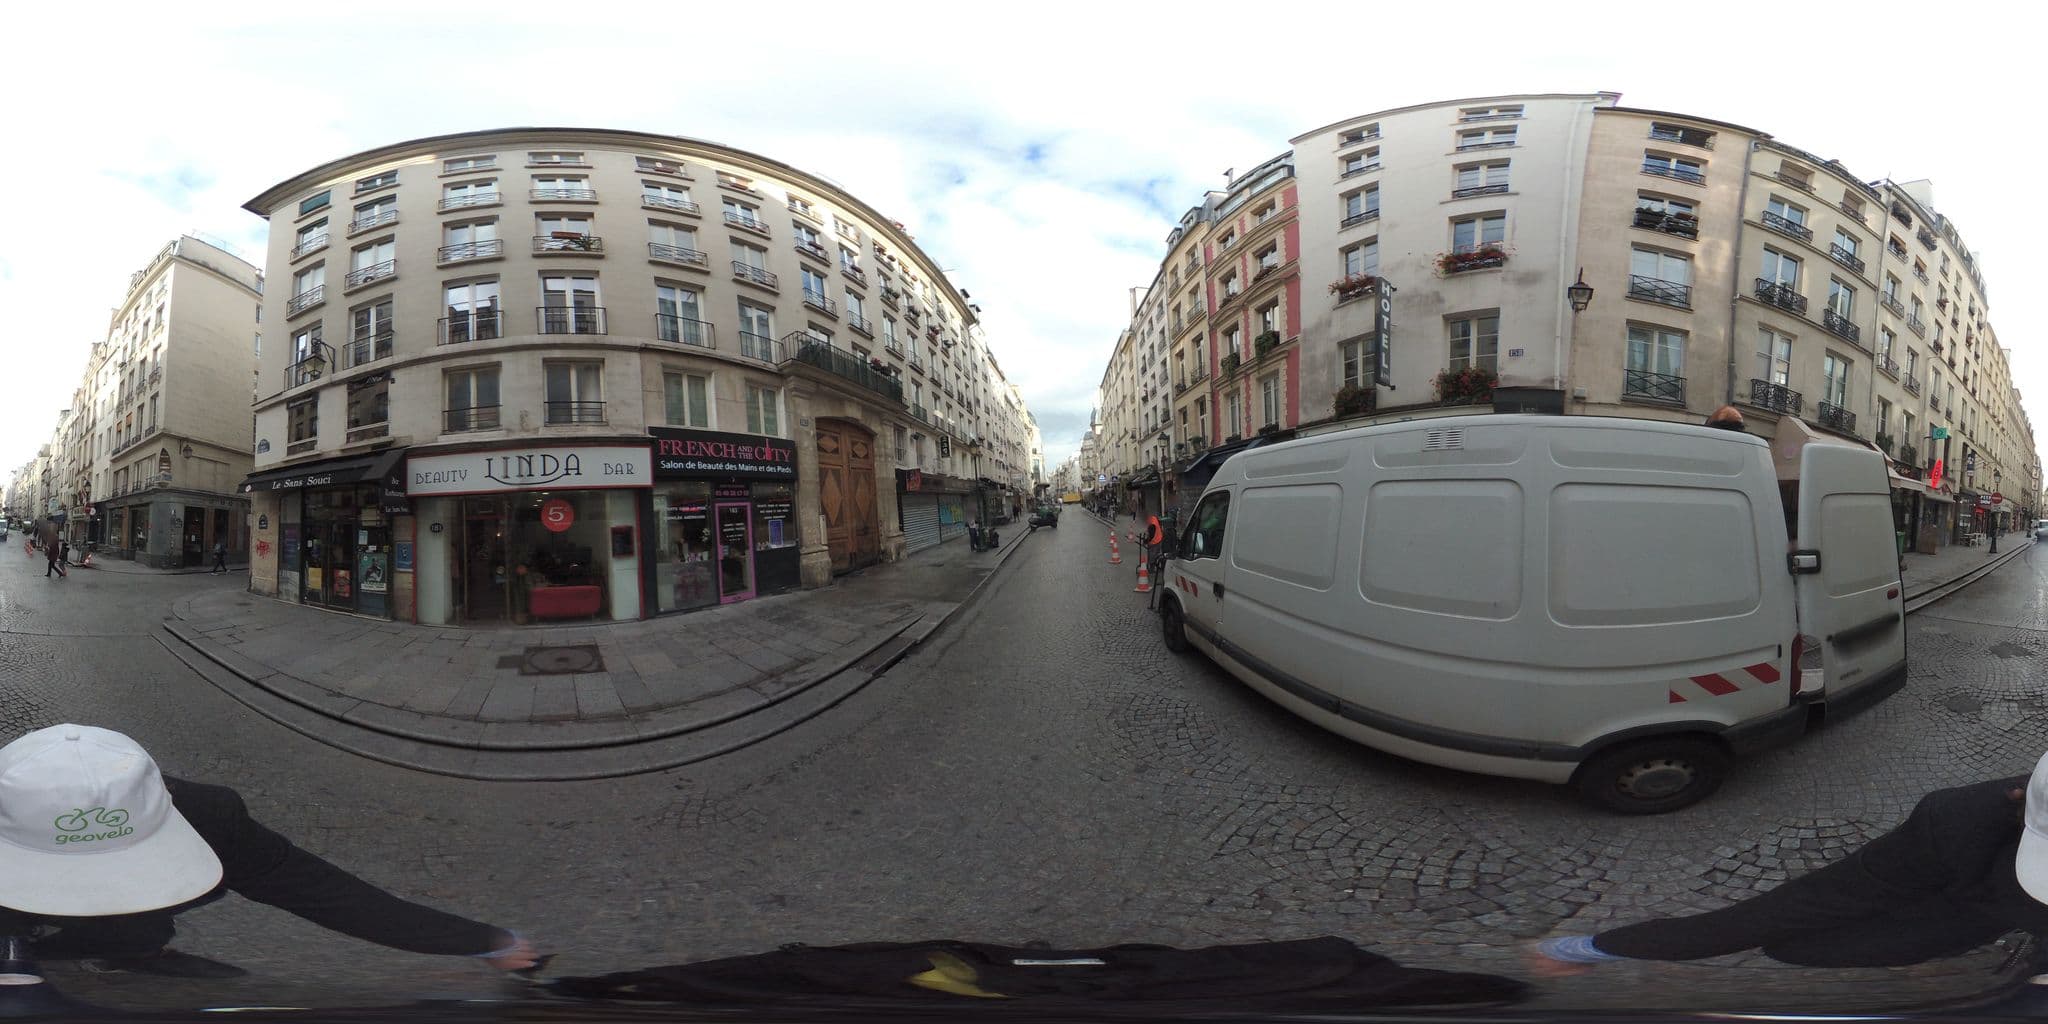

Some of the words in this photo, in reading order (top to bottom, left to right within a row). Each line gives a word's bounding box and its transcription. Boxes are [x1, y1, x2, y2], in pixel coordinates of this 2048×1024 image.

[1381, 282, 1391, 369] HOTEL
[659, 439, 736, 459] FRENCH
[737, 445, 753, 453] AND
[738, 452, 753, 460] THE
[415, 469, 468, 485] BEAUTY
[603, 462, 635, 476] BAR
[484, 453, 582, 486] LINDA
[660, 459, 684, 469] Salon
[685, 460, 696, 469] de
[697, 461, 723, 470] Beauté
[724, 462, 737, 471] des
[739, 463, 758, 472] Mains
[758, 464, 765, 472] et
[766, 464, 776, 473] des
[777, 465, 792, 474] Pieds
[271, 480, 281, 490] Le
[283, 478, 303, 489] Sans
[306, 474, 332, 486] Souci
[55, 826, 134, 845] geovelo
